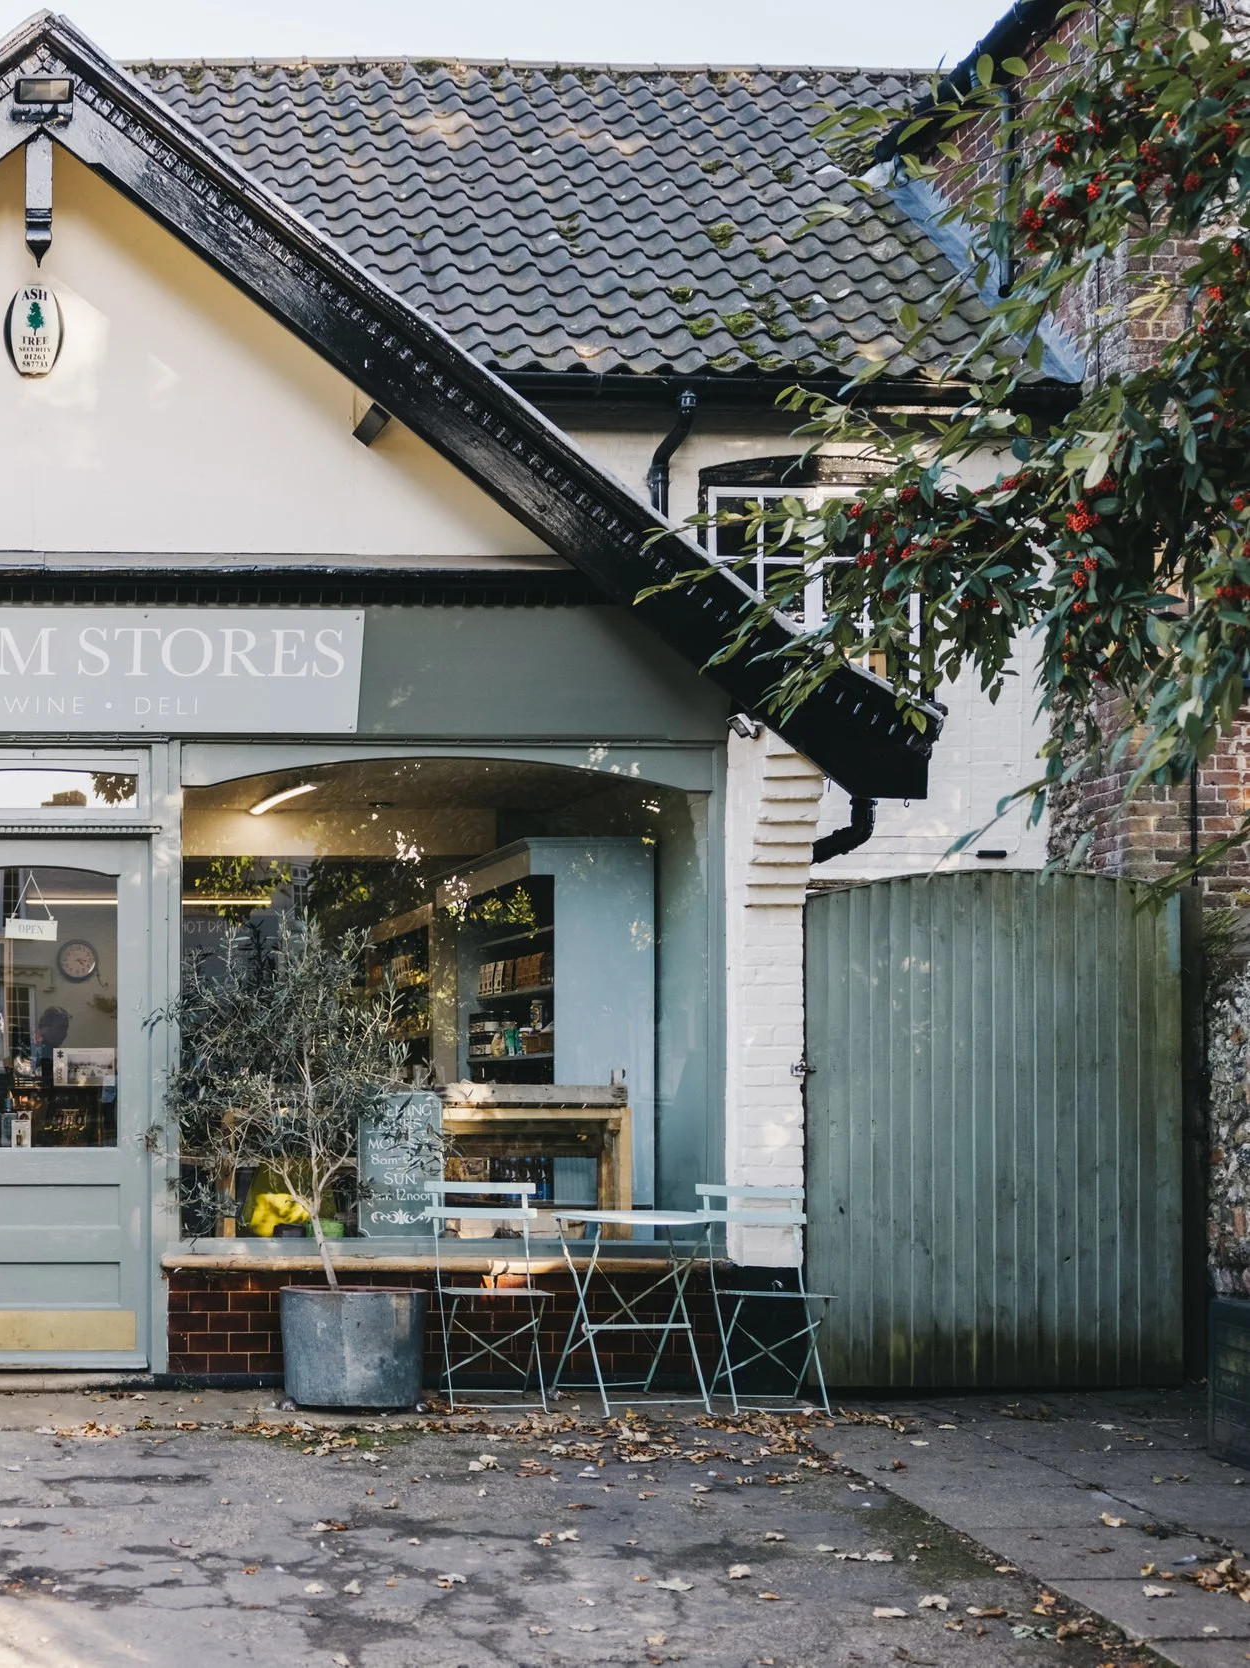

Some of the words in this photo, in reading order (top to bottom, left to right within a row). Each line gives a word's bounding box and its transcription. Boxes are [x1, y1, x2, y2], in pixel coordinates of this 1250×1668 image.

[21, 288, 48, 301] ASH
[21, 335, 49, 346] TREE
[77, 626, 346, 678] STORES
[3, 695, 86, 716] WINE
[134, 696, 199, 716] DELI
[18, 923, 45, 934] OPEN
[383, 1172, 417, 1185] SUN
